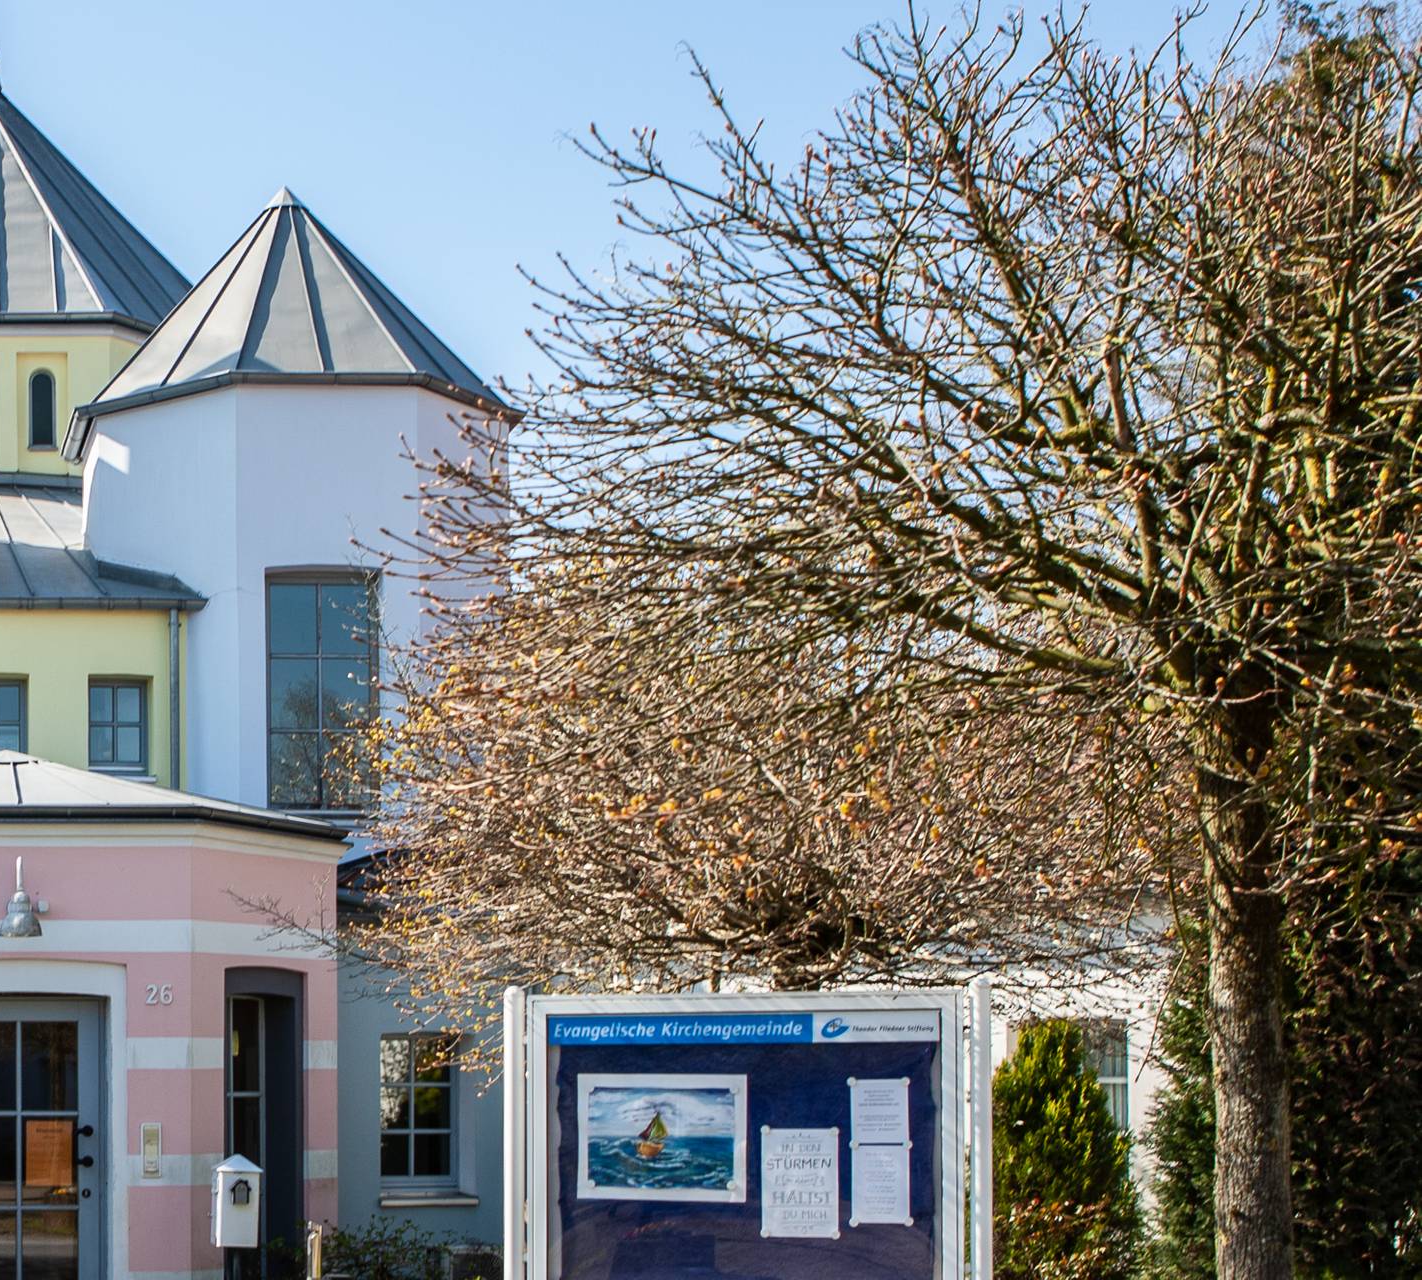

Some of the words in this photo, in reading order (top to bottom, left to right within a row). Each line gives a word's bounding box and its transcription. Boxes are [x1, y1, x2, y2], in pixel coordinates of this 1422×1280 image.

[145, 983, 174, 1005] 26
[554, 1023, 656, 1041] Evangelische
[661, 1020, 804, 1040] Kirchengemeinde
[852, 1024, 877, 1033] Theodor
[879, 1024, 906, 1033] Fliedner
[907, 1023, 934, 1033] Stiftung
[766, 1154, 832, 1170] STÜRMEN
